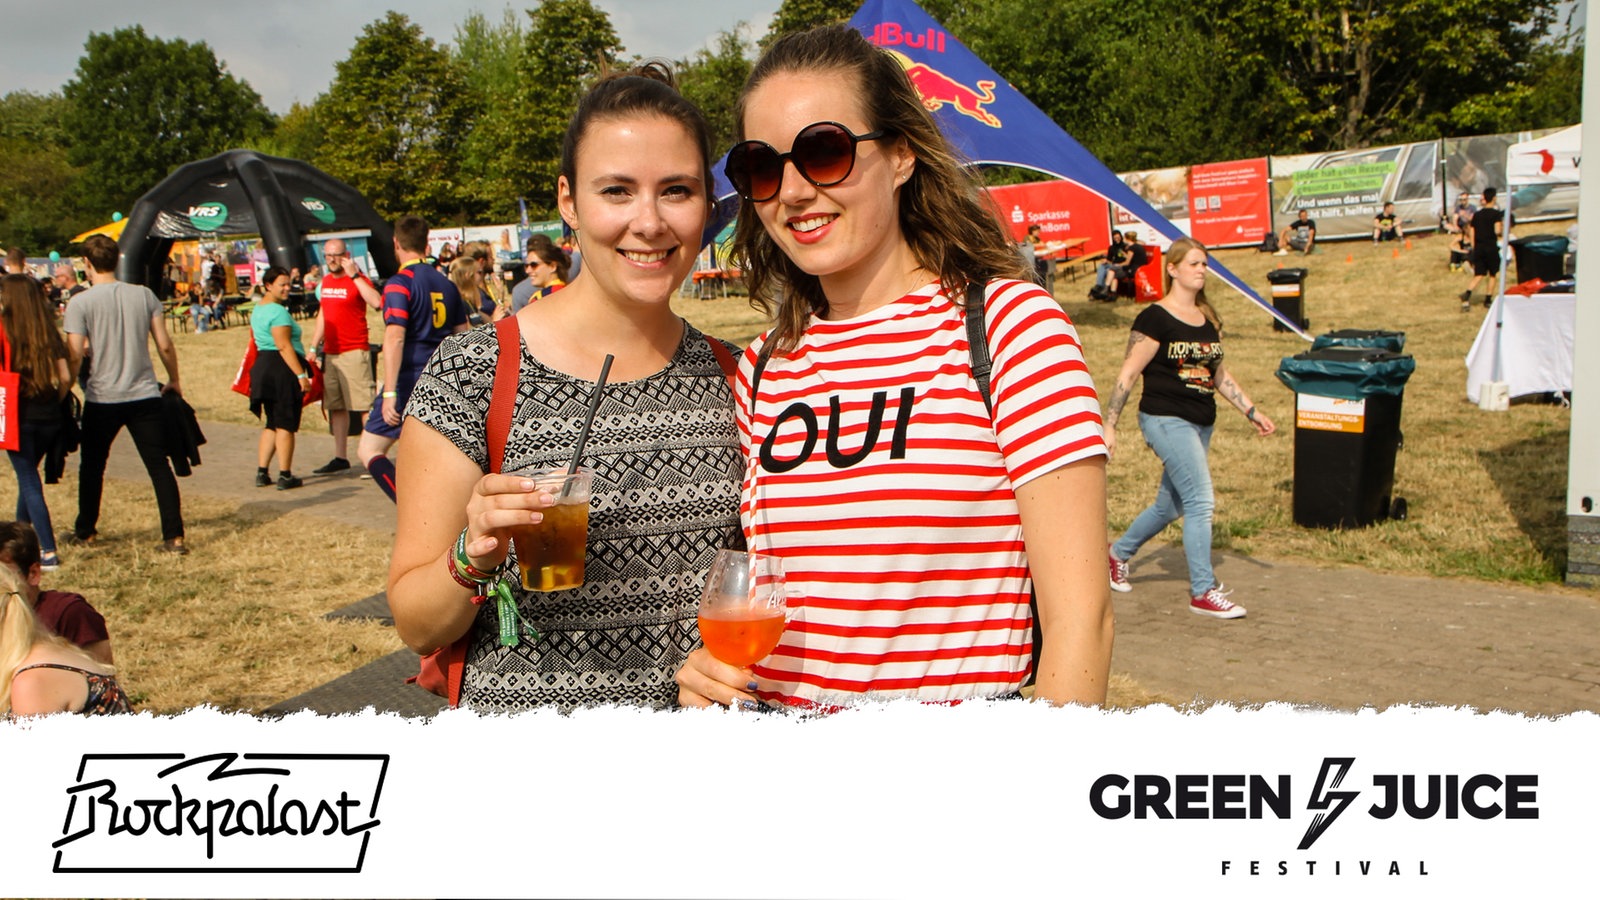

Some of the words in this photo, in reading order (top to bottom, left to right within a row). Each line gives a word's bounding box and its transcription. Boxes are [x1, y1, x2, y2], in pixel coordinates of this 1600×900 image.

[301, 201, 325, 211] VRS
[1297, 198, 1315, 208] Und
[1317, 198, 1342, 207] wenn
[1343, 195, 1360, 204] das
[1361, 192, 1379, 203] mal
[188, 205, 220, 217] VRS
[1027, 210, 1070, 222] Sparkasse
[429, 292, 446, 330] 5
[759, 387, 915, 473] OUI
